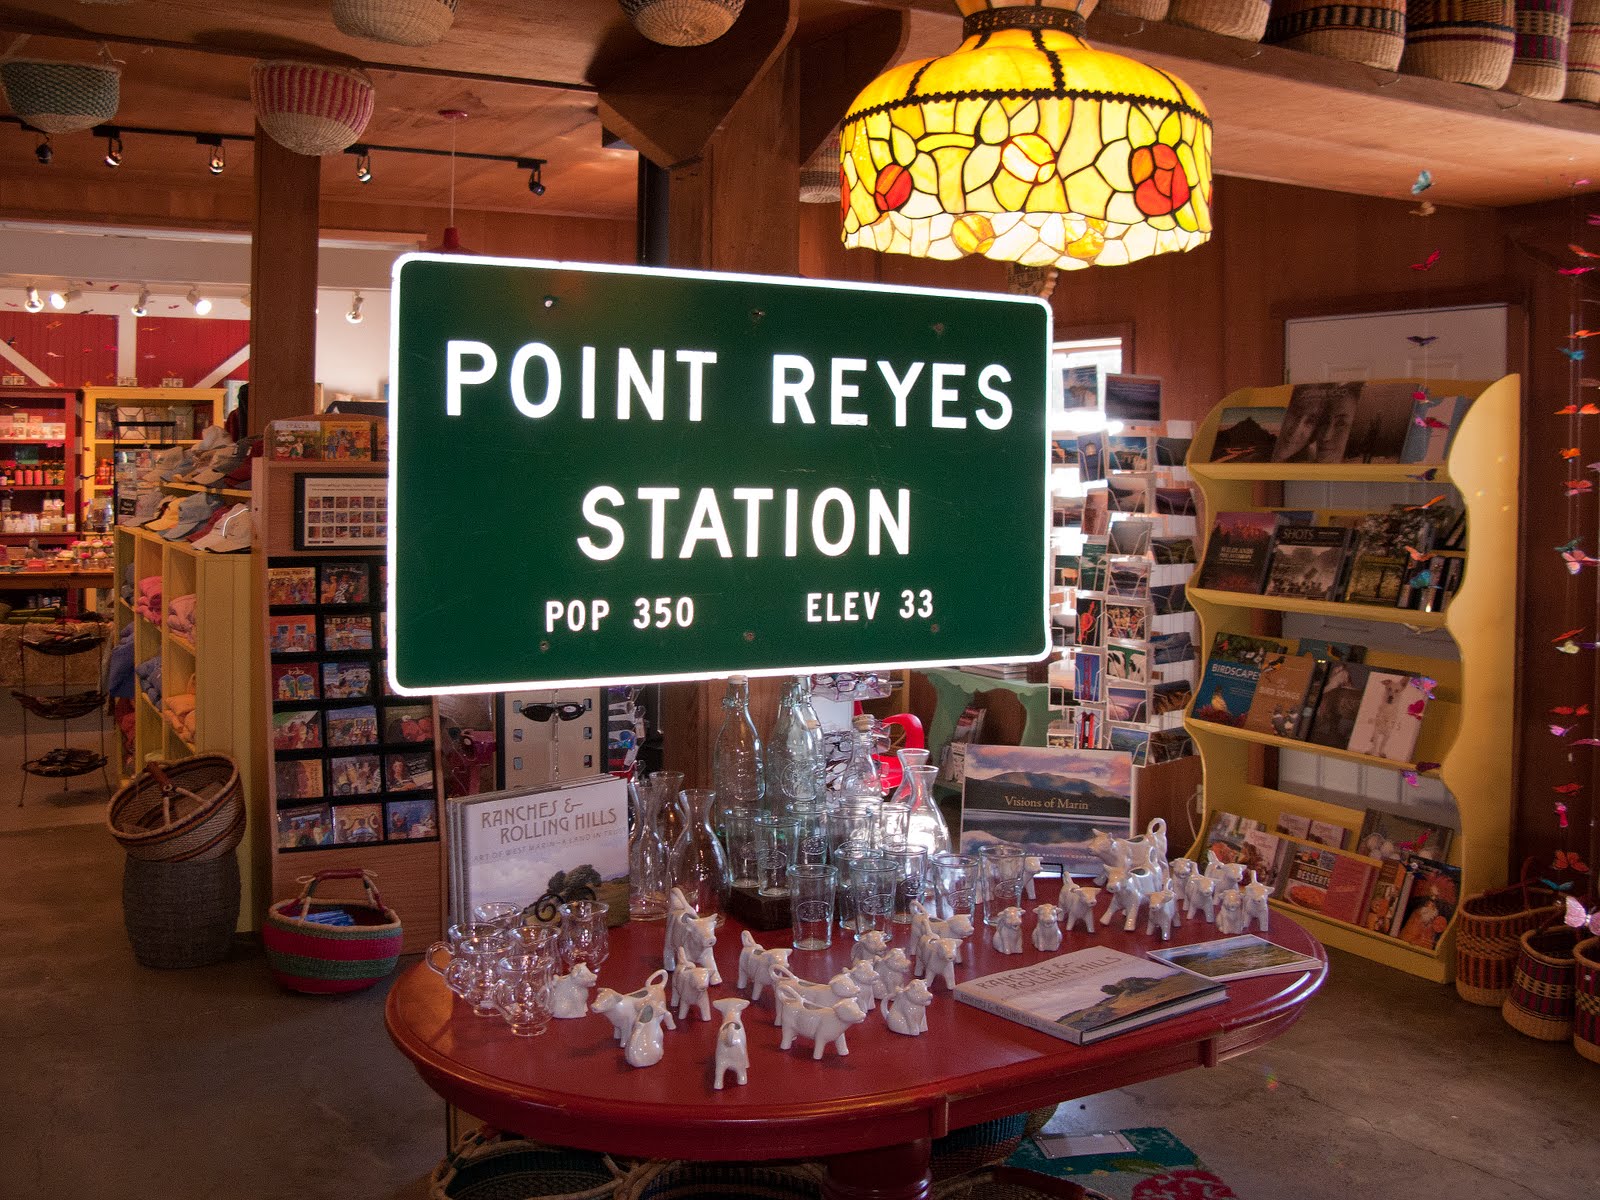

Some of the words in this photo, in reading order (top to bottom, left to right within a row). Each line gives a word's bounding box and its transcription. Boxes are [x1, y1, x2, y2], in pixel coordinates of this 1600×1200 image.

[446, 340, 718, 422] POINT
[772, 354, 1013, 431] REYES
[576, 485, 910, 563] STATION
[546, 599, 610, 633] POP
[633, 596, 694, 629] 350
[807, 591, 880, 623] ELEV
[899, 589, 933, 619] 33
[482, 799, 558, 829] RANCHES
[564, 797, 585, 814] &
[1004, 795, 1042, 807] Visions
[1044, 797, 1056, 808] of
[1057, 798, 1089, 810] Marin
[501, 816, 569, 844] ROLLING
[575, 808, 617, 830] HILLS
[976, 966, 1050, 989] RANCHES
[1008, 967, 1081, 990] ROLLING
[1080, 956, 1121, 972] HILLS
